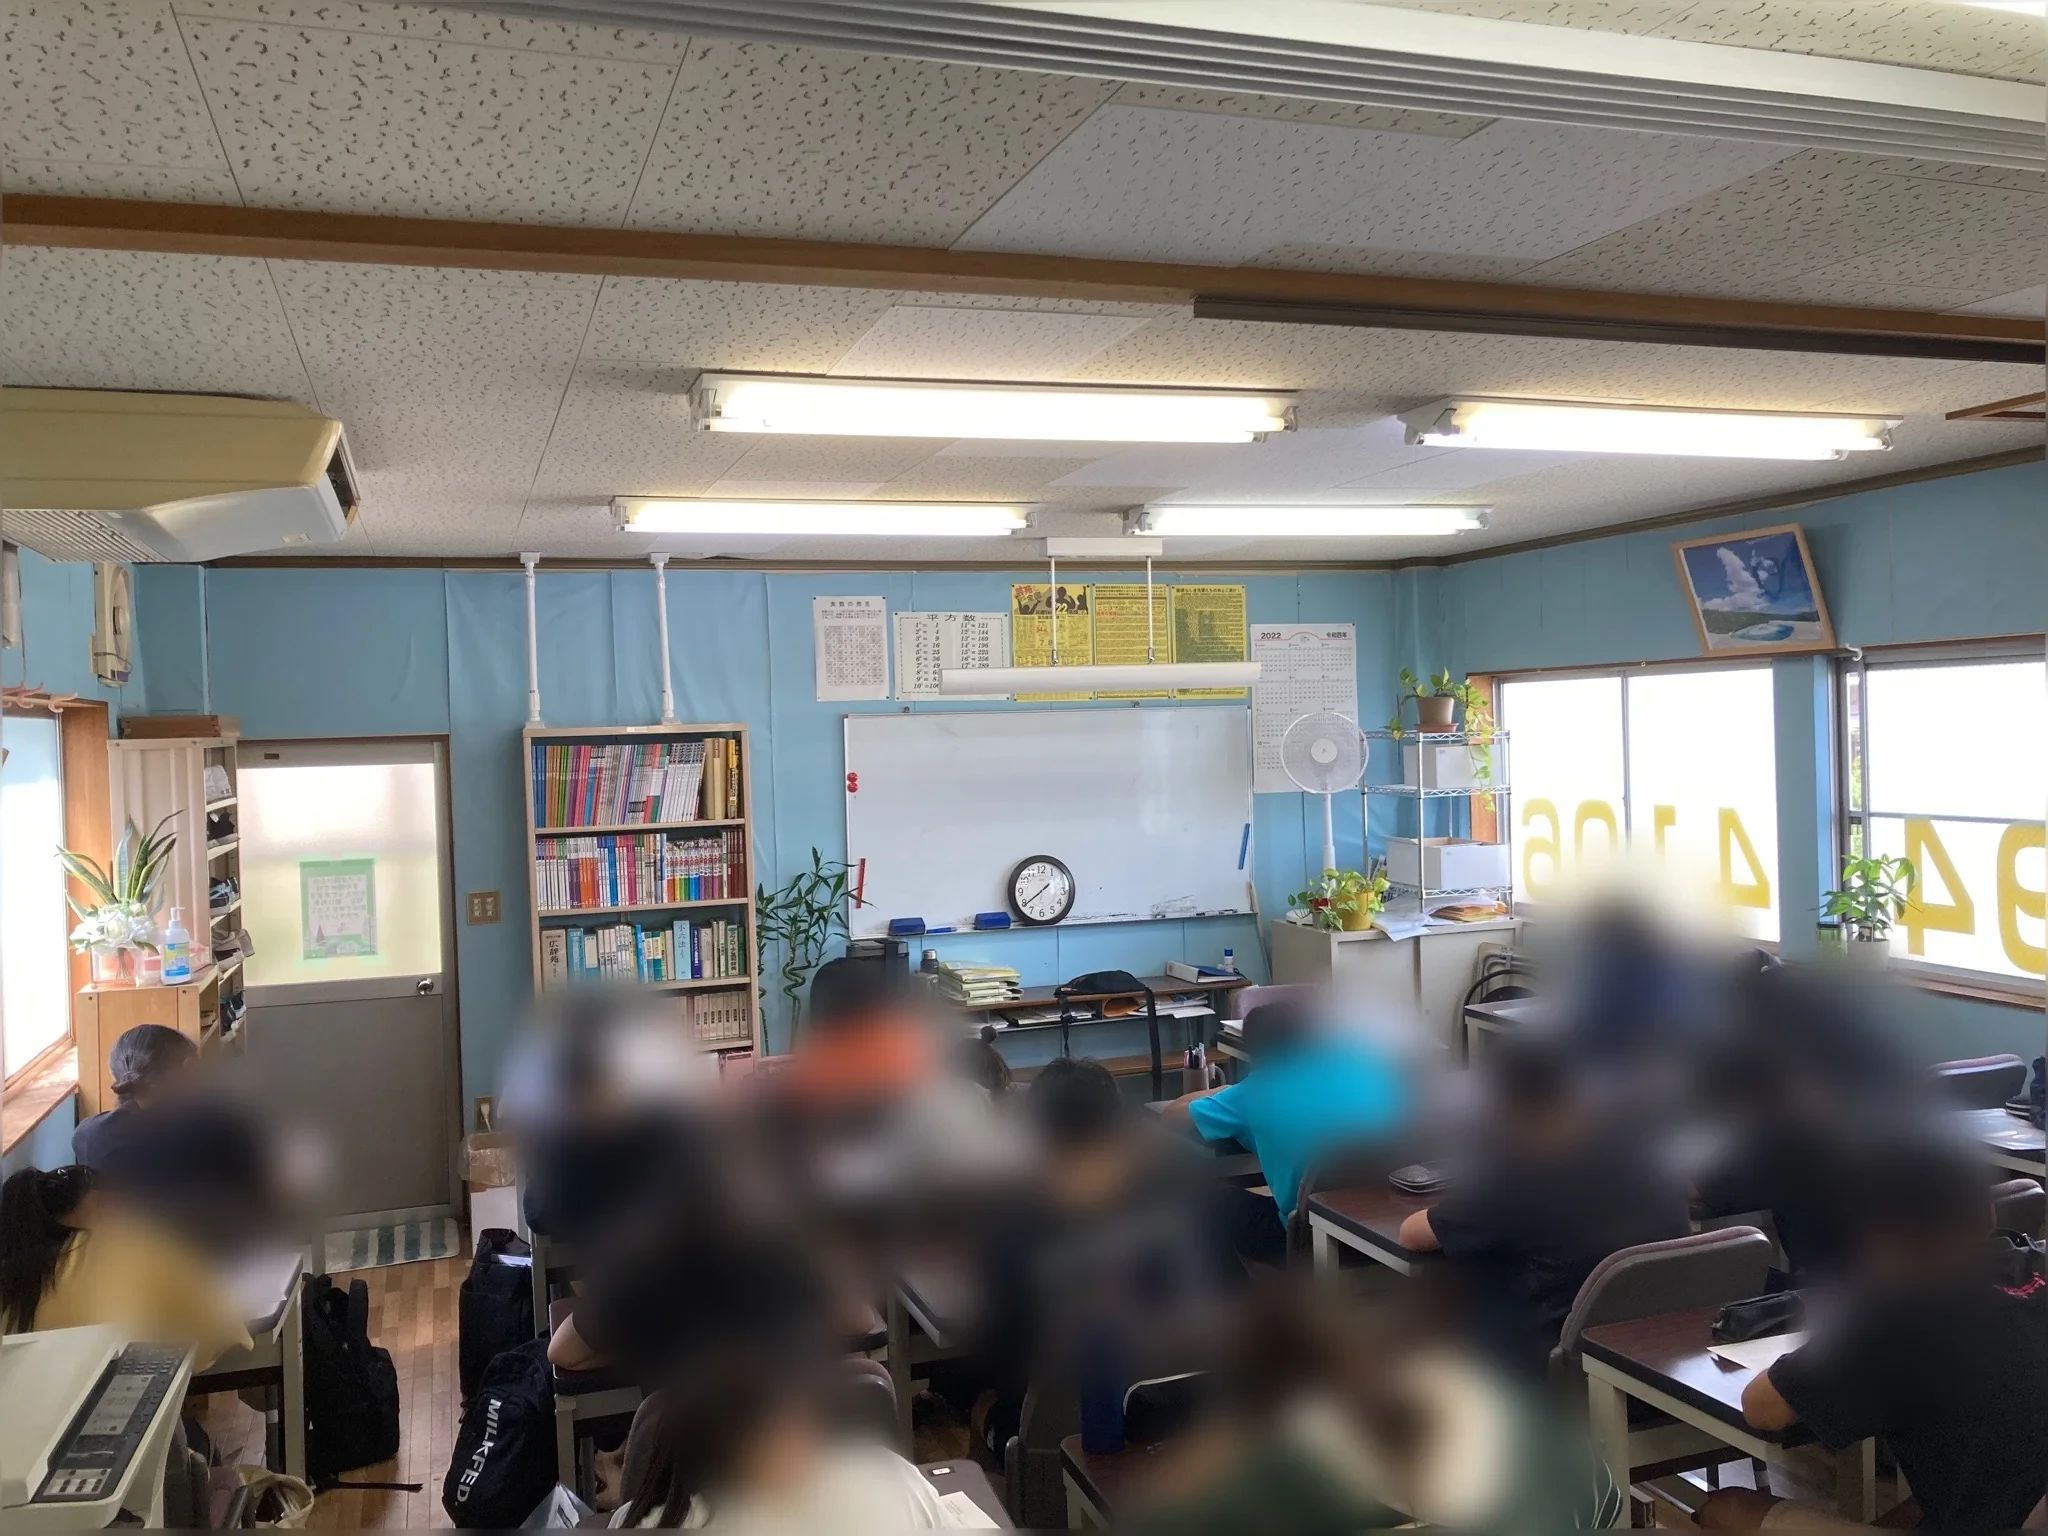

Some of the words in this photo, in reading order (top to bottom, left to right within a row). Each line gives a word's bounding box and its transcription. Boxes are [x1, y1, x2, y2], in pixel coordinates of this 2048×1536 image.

[926, 614, 976, 622] 平方数
[1260, 632, 1282, 640] 2022
[1037, 865, 1046, 874] 12
[1050, 868, 1054, 877] 1
[1017, 887, 1024, 896] 9
[1060, 887, 1066, 896] 3
[1021, 898, 1028, 907] 8
[1057, 898, 1062, 907] 4
[1028, 906, 1035, 915] 7
[1039, 908, 1045, 917] 6
[1049, 906, 1055, 915] 5
